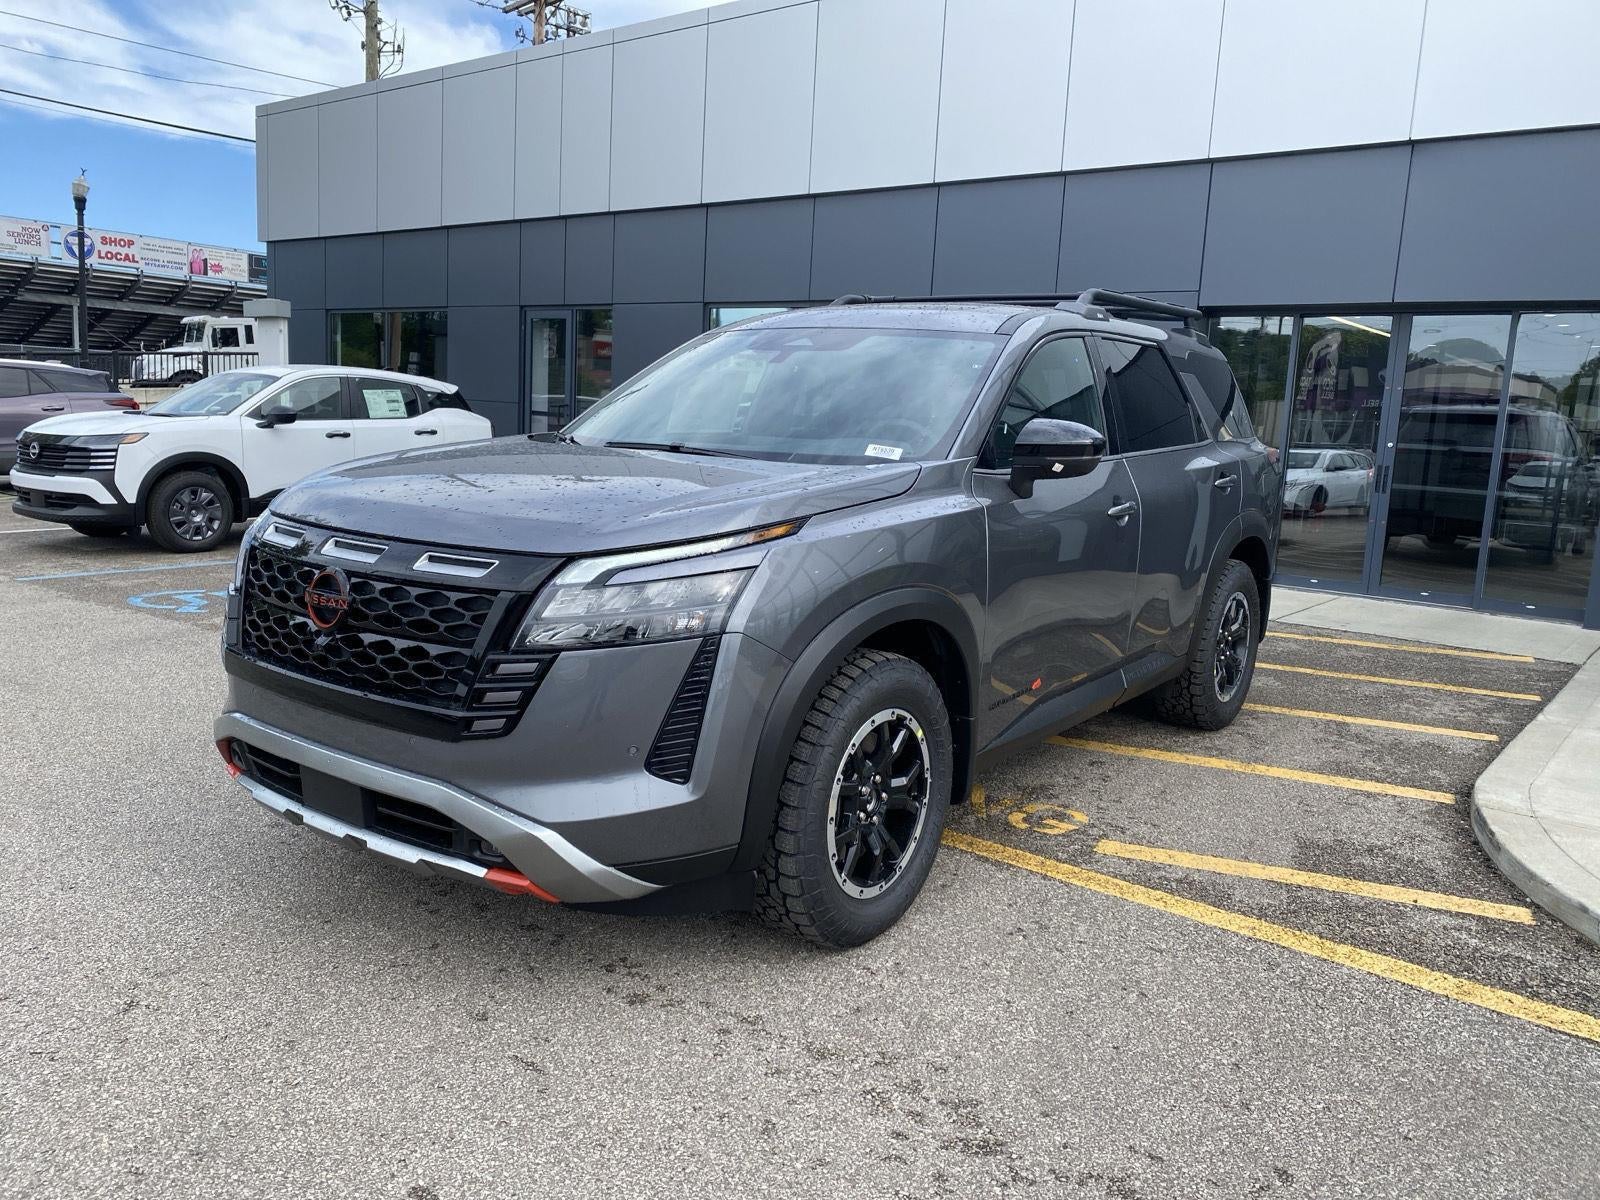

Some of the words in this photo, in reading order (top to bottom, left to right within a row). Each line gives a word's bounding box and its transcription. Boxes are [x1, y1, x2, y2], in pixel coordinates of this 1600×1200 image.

[6, 230, 41, 240] SERVING
[21, 226, 41, 234] NOW
[14, 237, 41, 247] LUNCH
[100, 235, 135, 249] SHOP
[97, 249, 139, 264] LOCAL
